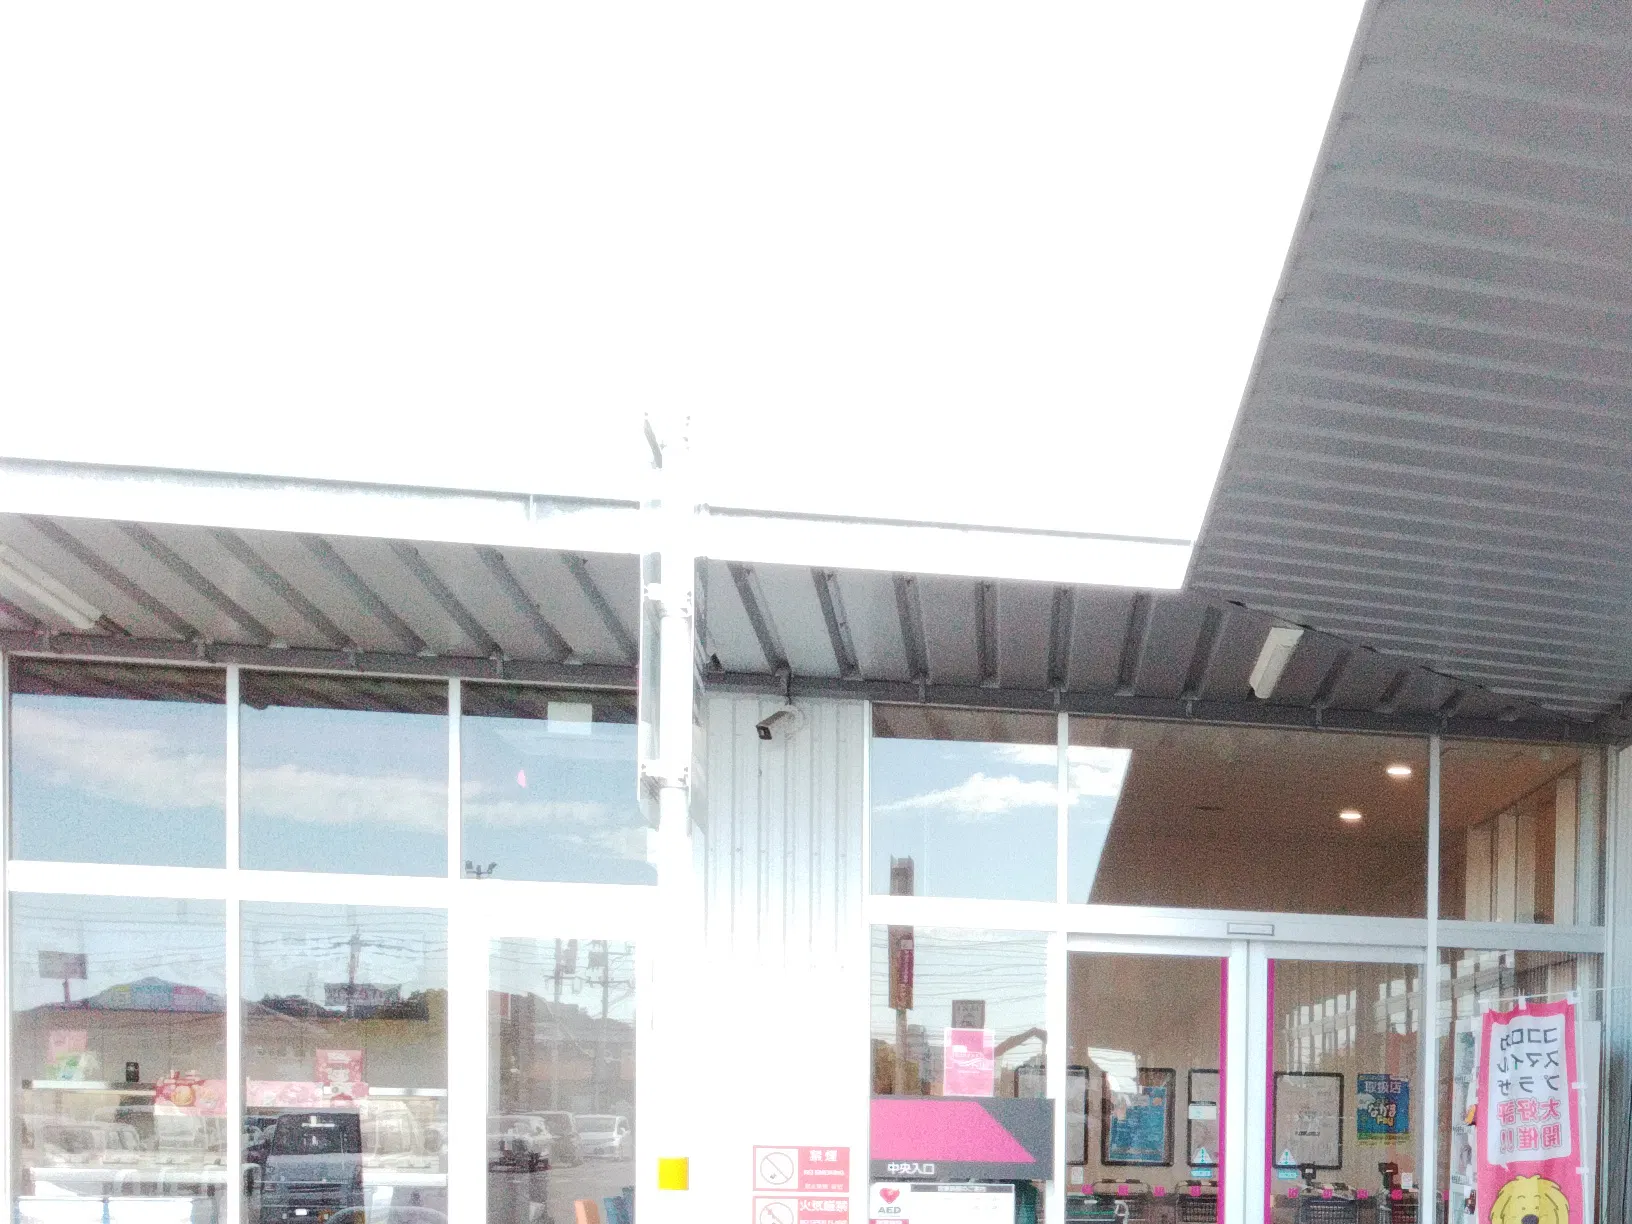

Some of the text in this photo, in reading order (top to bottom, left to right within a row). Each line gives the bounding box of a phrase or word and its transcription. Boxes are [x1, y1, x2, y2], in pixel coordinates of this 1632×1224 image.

[1364, 1081, 1402, 1094] 取扱店
[887, 1161, 935, 1175] 中央入口
[878, 1206, 902, 1214] AED
